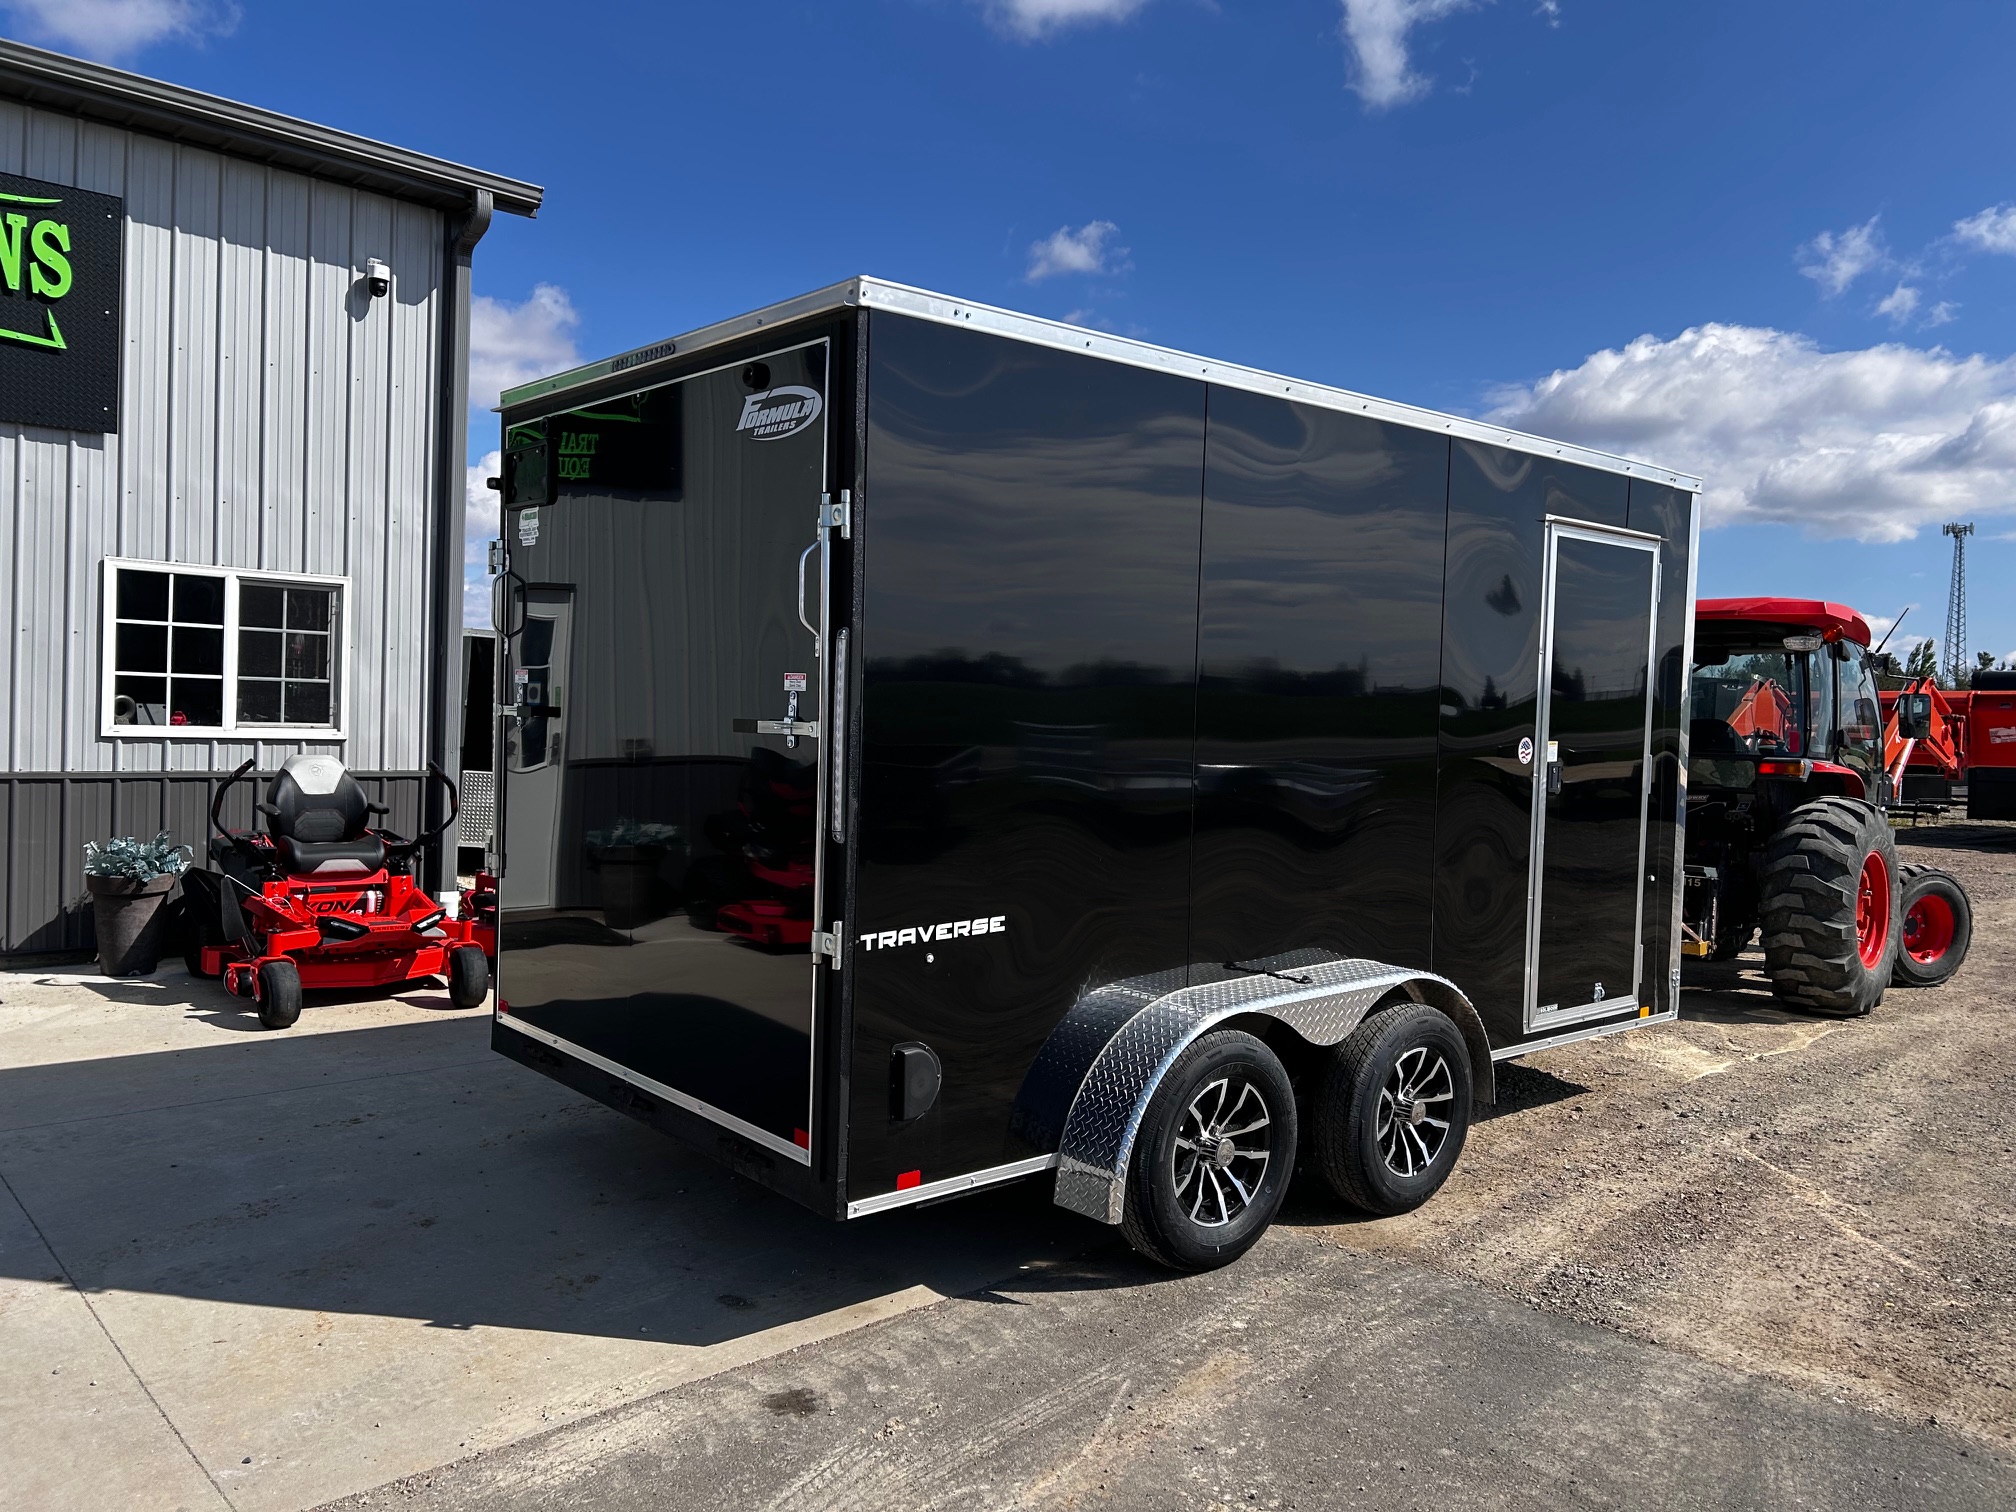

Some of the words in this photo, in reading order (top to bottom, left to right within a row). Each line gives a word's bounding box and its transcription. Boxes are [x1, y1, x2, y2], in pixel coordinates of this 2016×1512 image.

[735, 390, 815, 431] FORMULA
[753, 420, 797, 436] TRAILERS
[860, 915, 1006, 951] TRAVERSE
